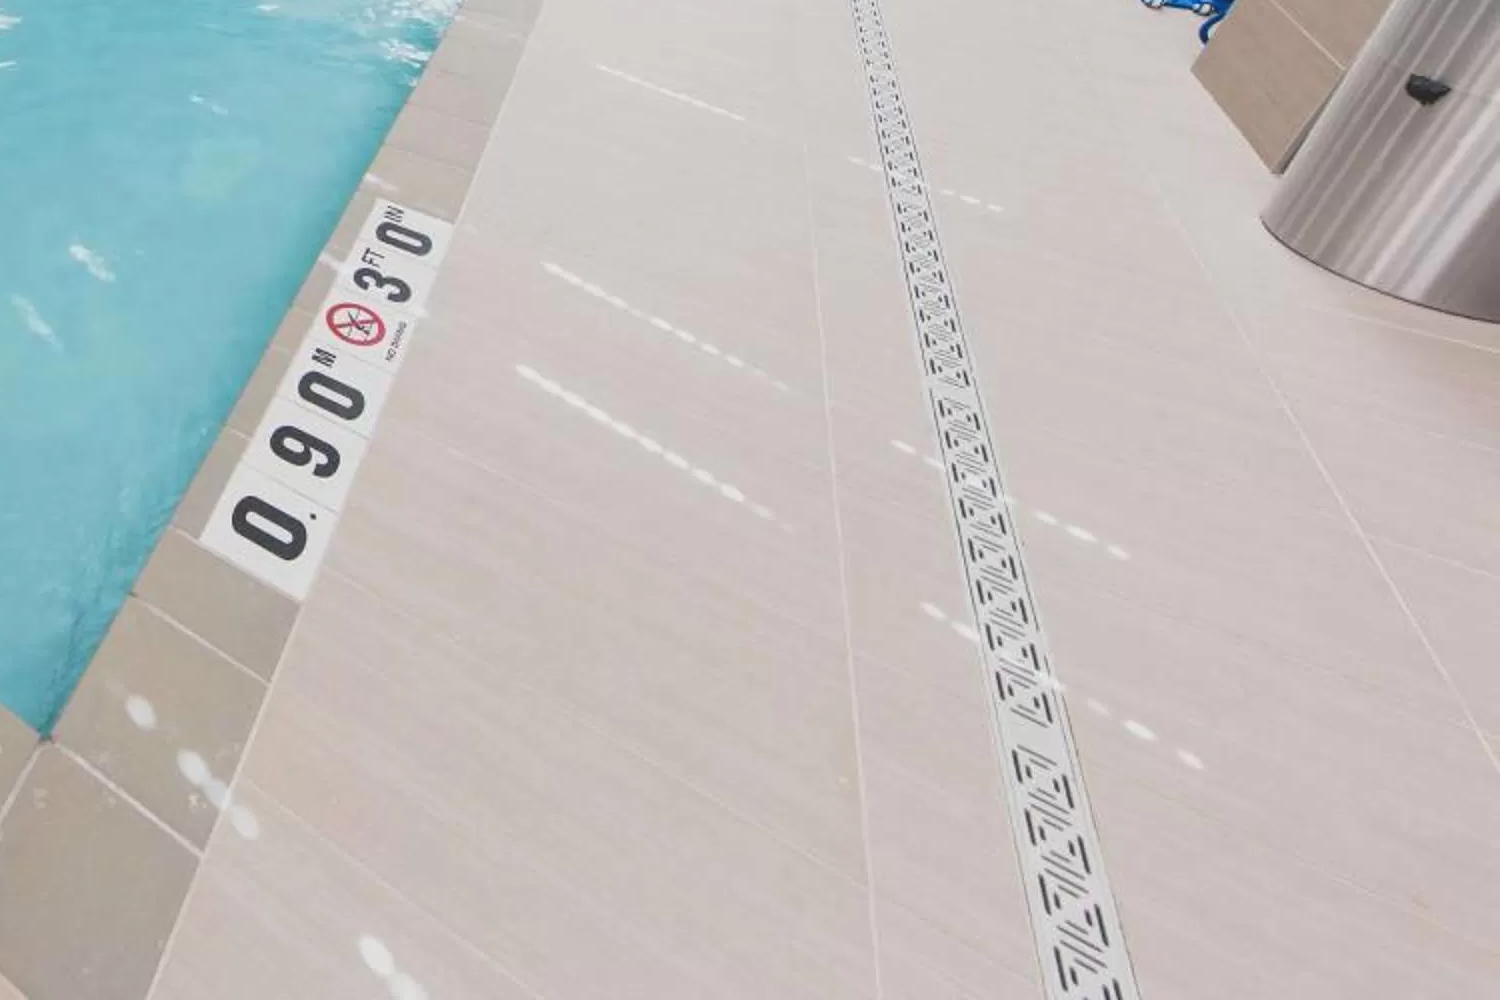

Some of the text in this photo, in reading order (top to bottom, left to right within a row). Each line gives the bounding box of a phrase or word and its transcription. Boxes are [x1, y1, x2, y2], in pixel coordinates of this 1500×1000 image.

[376, 222, 433, 256] 0
[361, 248, 385, 268] FT
[353, 267, 411, 302] 3
